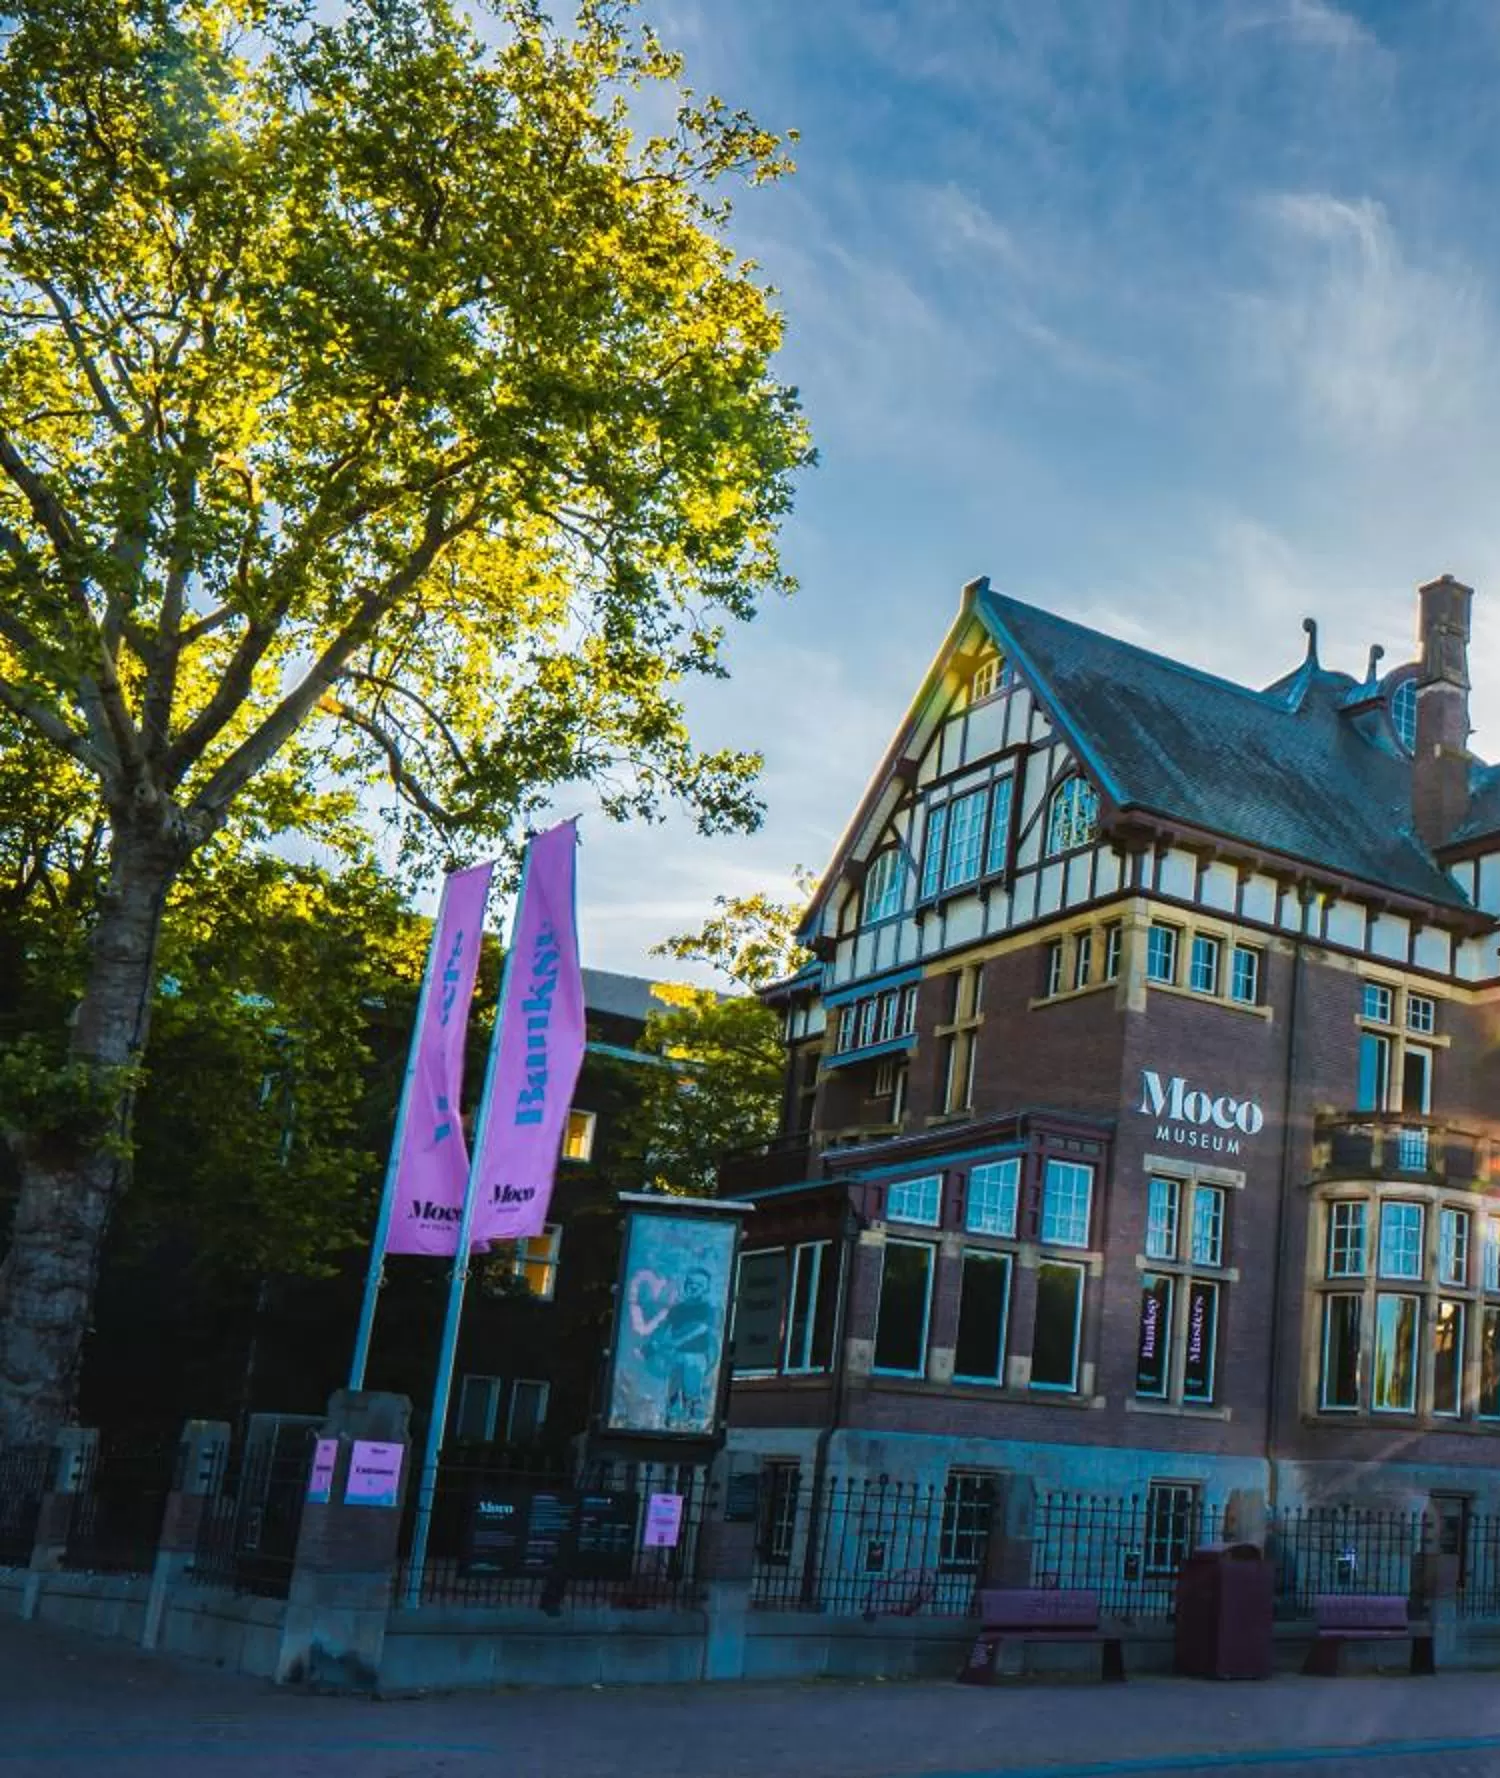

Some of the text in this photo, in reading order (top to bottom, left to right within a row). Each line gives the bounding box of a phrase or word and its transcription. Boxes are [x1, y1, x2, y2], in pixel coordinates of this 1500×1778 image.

[1136, 1069, 1264, 1135] Moco
[1156, 1125, 1240, 1155] MUSEUM
[488, 1184, 536, 1204] Moco
[1142, 1296, 1160, 1358] Banksy
[1189, 1295, 1204, 1362] Masters
